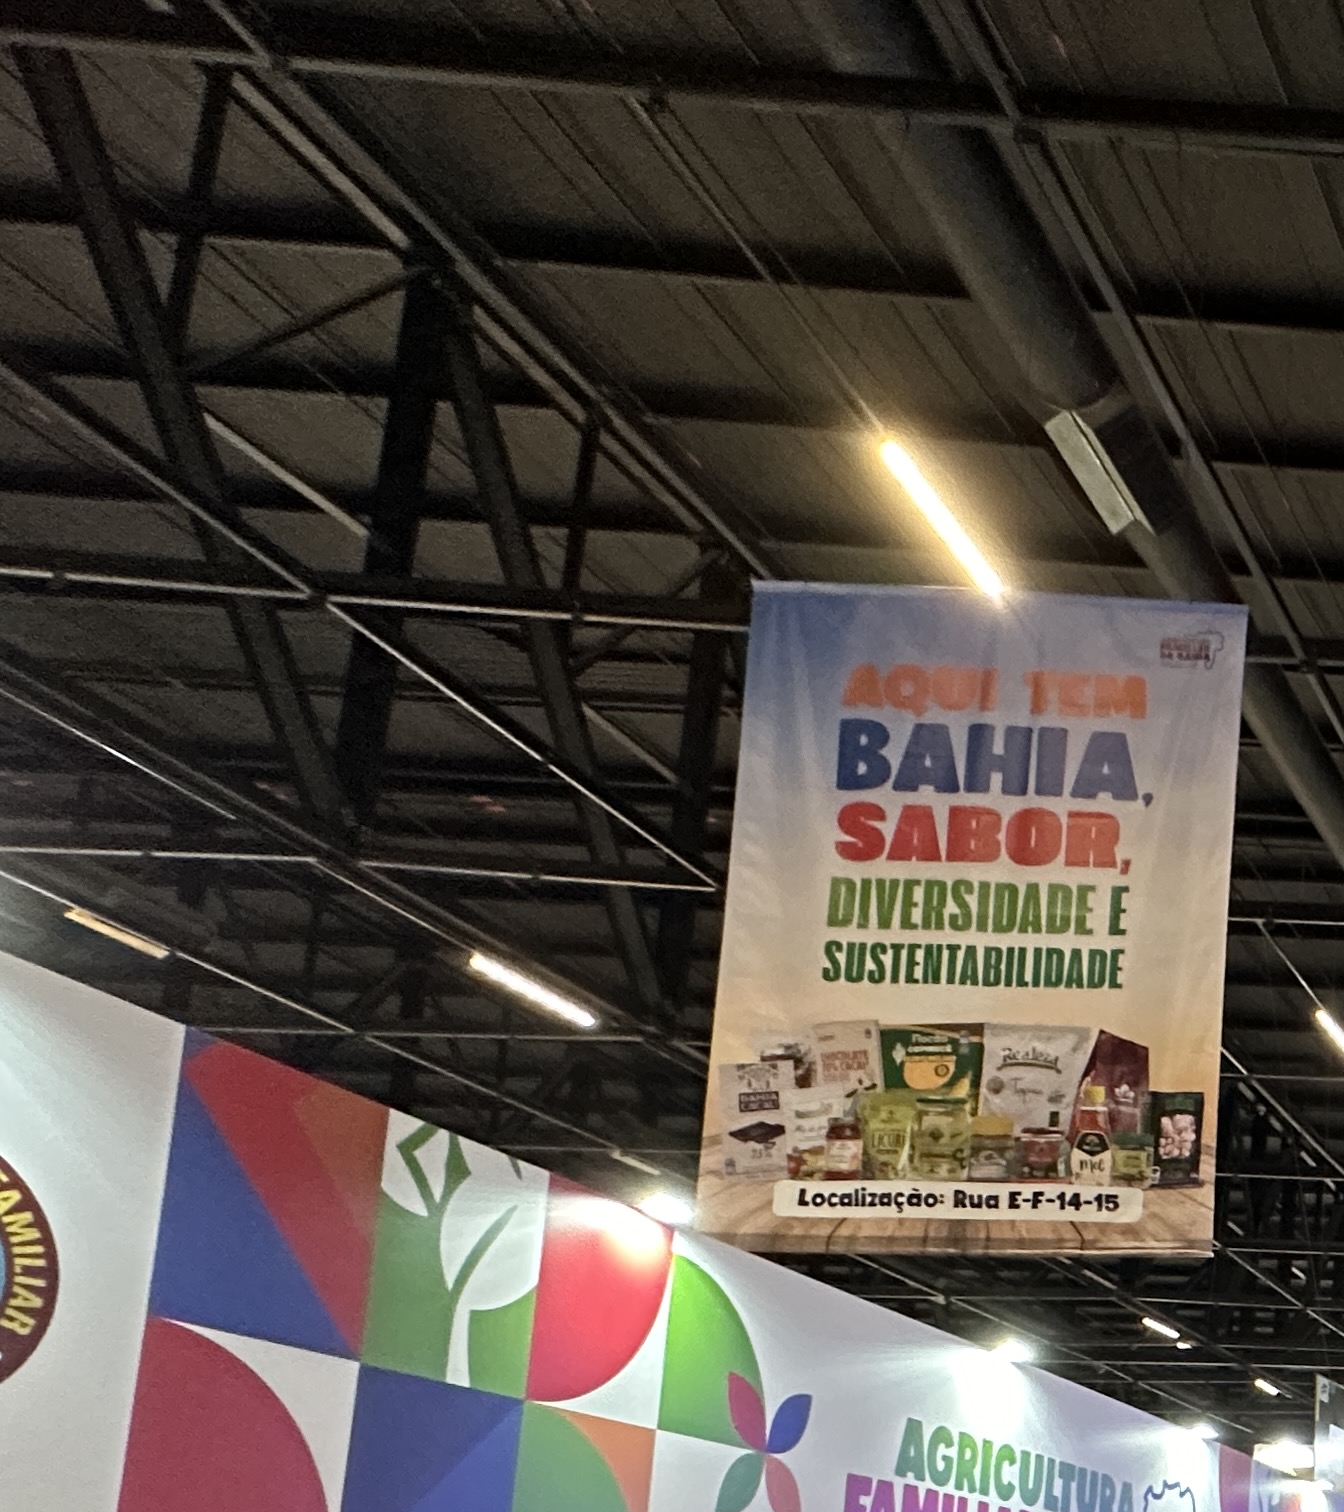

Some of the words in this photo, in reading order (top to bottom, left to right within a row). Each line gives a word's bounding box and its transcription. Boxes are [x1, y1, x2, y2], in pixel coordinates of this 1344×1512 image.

[842, 662, 998, 716] AQUI
[1024, 669, 1148, 719] TEM
[835, 718, 1154, 807] BAHIA,
[835, 802, 1132, 875] SABOR,
[826, 876, 1096, 936] DIVERSIDADE
[1109, 885, 1129, 936] E
[822, 941, 1125, 990] SUSTENTABILIDADE
[798, 1187, 946, 1213] Localização:
[953, 1190, 1000, 1211] Rua
[1007, 1192, 1120, 1212] E-F-14-15
[0, 1168, 47, 1336] AMILIAR
